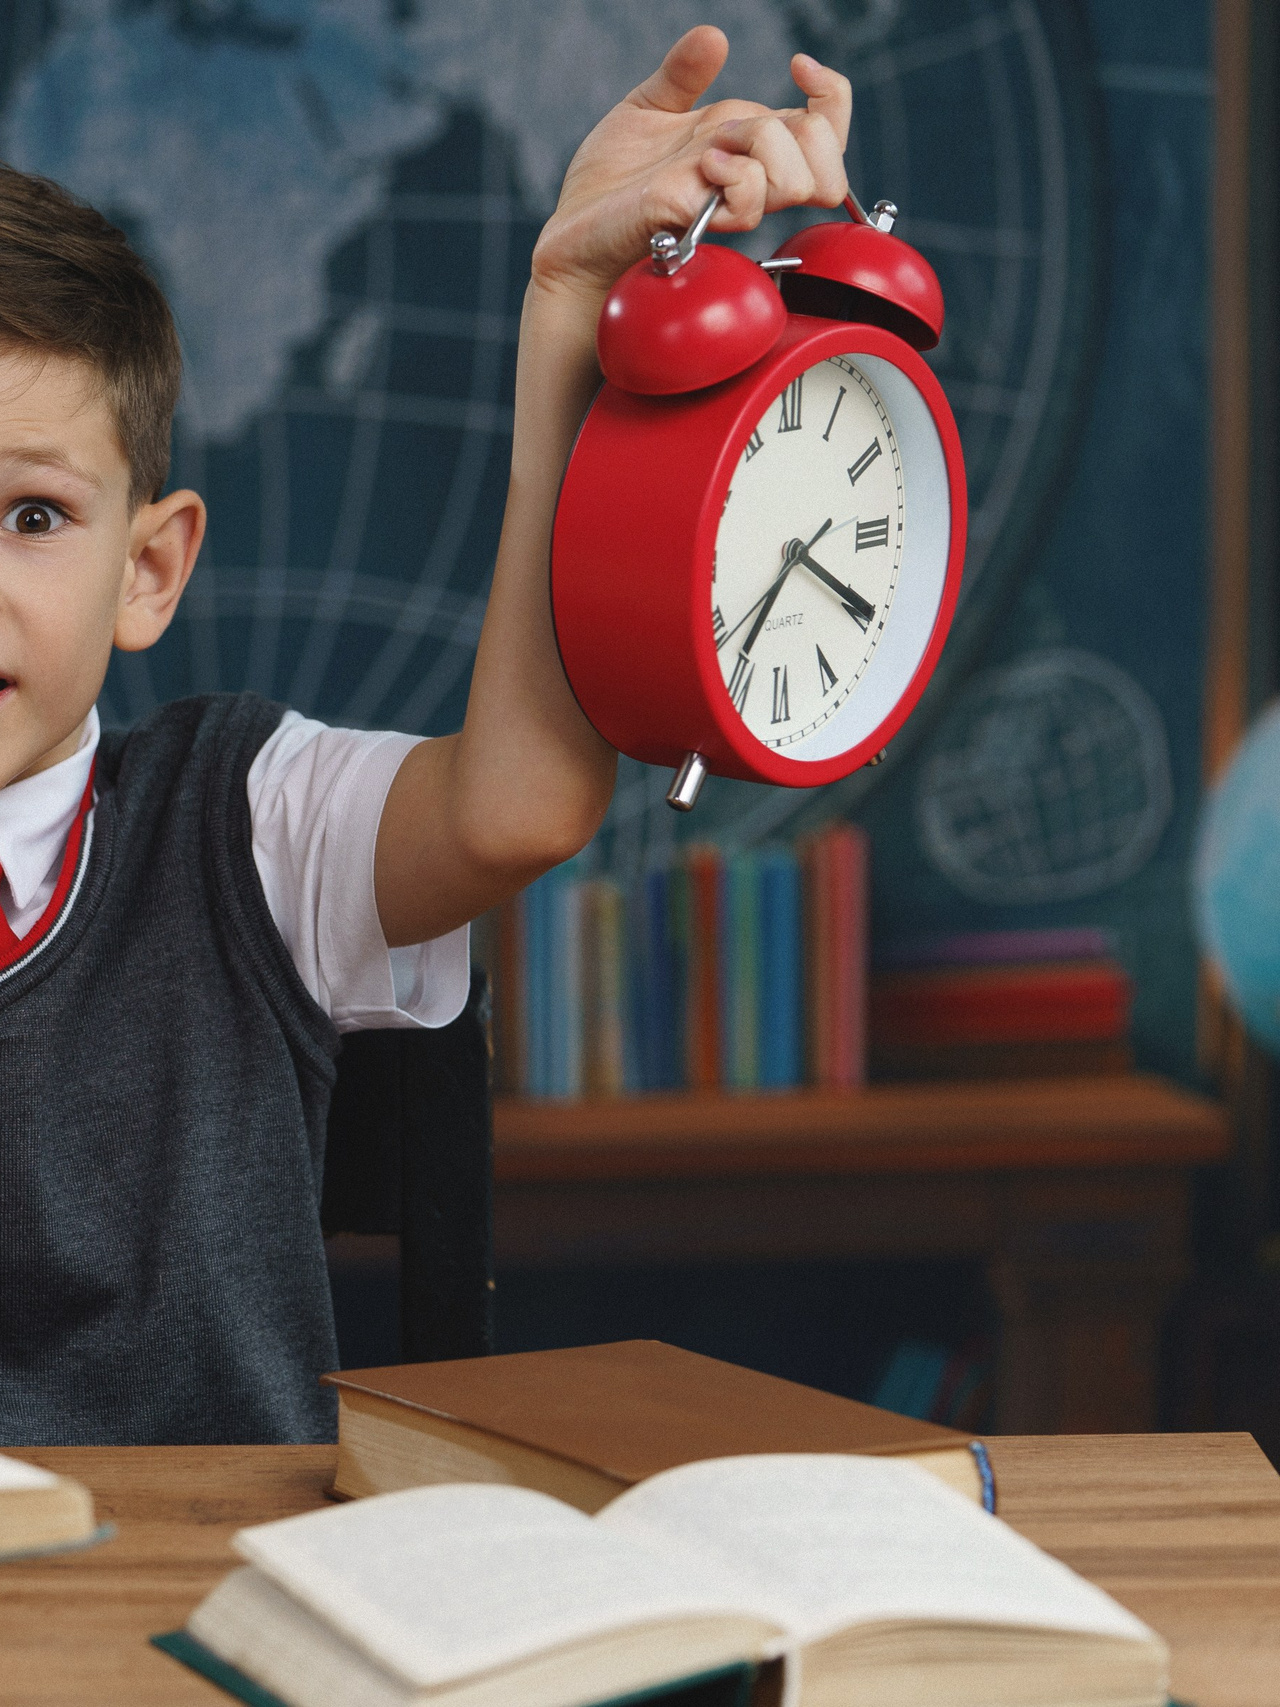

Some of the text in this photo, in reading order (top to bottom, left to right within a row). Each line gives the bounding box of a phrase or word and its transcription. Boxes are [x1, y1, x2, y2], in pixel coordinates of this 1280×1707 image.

[822, 385, 847, 442] I
[847, 436, 883, 487] II
[855, 514, 890, 554] III
[765, 613, 804, 632] QUARTZ
[770, 664, 791, 724] VI
[816, 643, 839, 697] V
